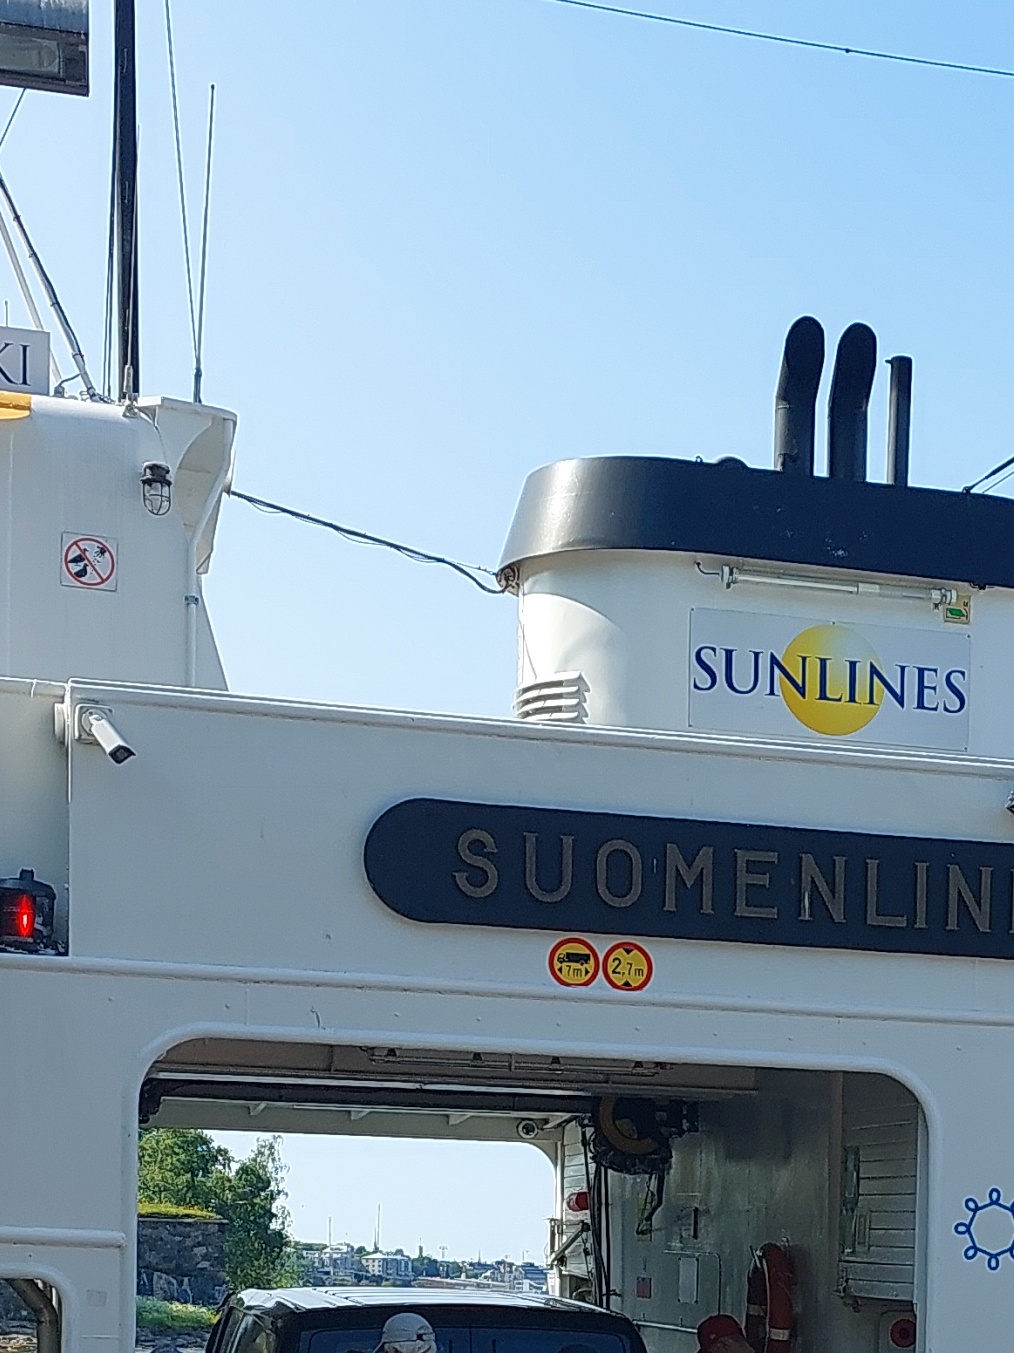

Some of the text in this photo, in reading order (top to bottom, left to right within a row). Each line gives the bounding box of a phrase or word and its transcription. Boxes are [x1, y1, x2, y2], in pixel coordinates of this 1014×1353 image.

[693, 645, 967, 714] SUNLINES
[565, 965, 583, 978] 7m
[611, 957, 645, 978] 2,7m
